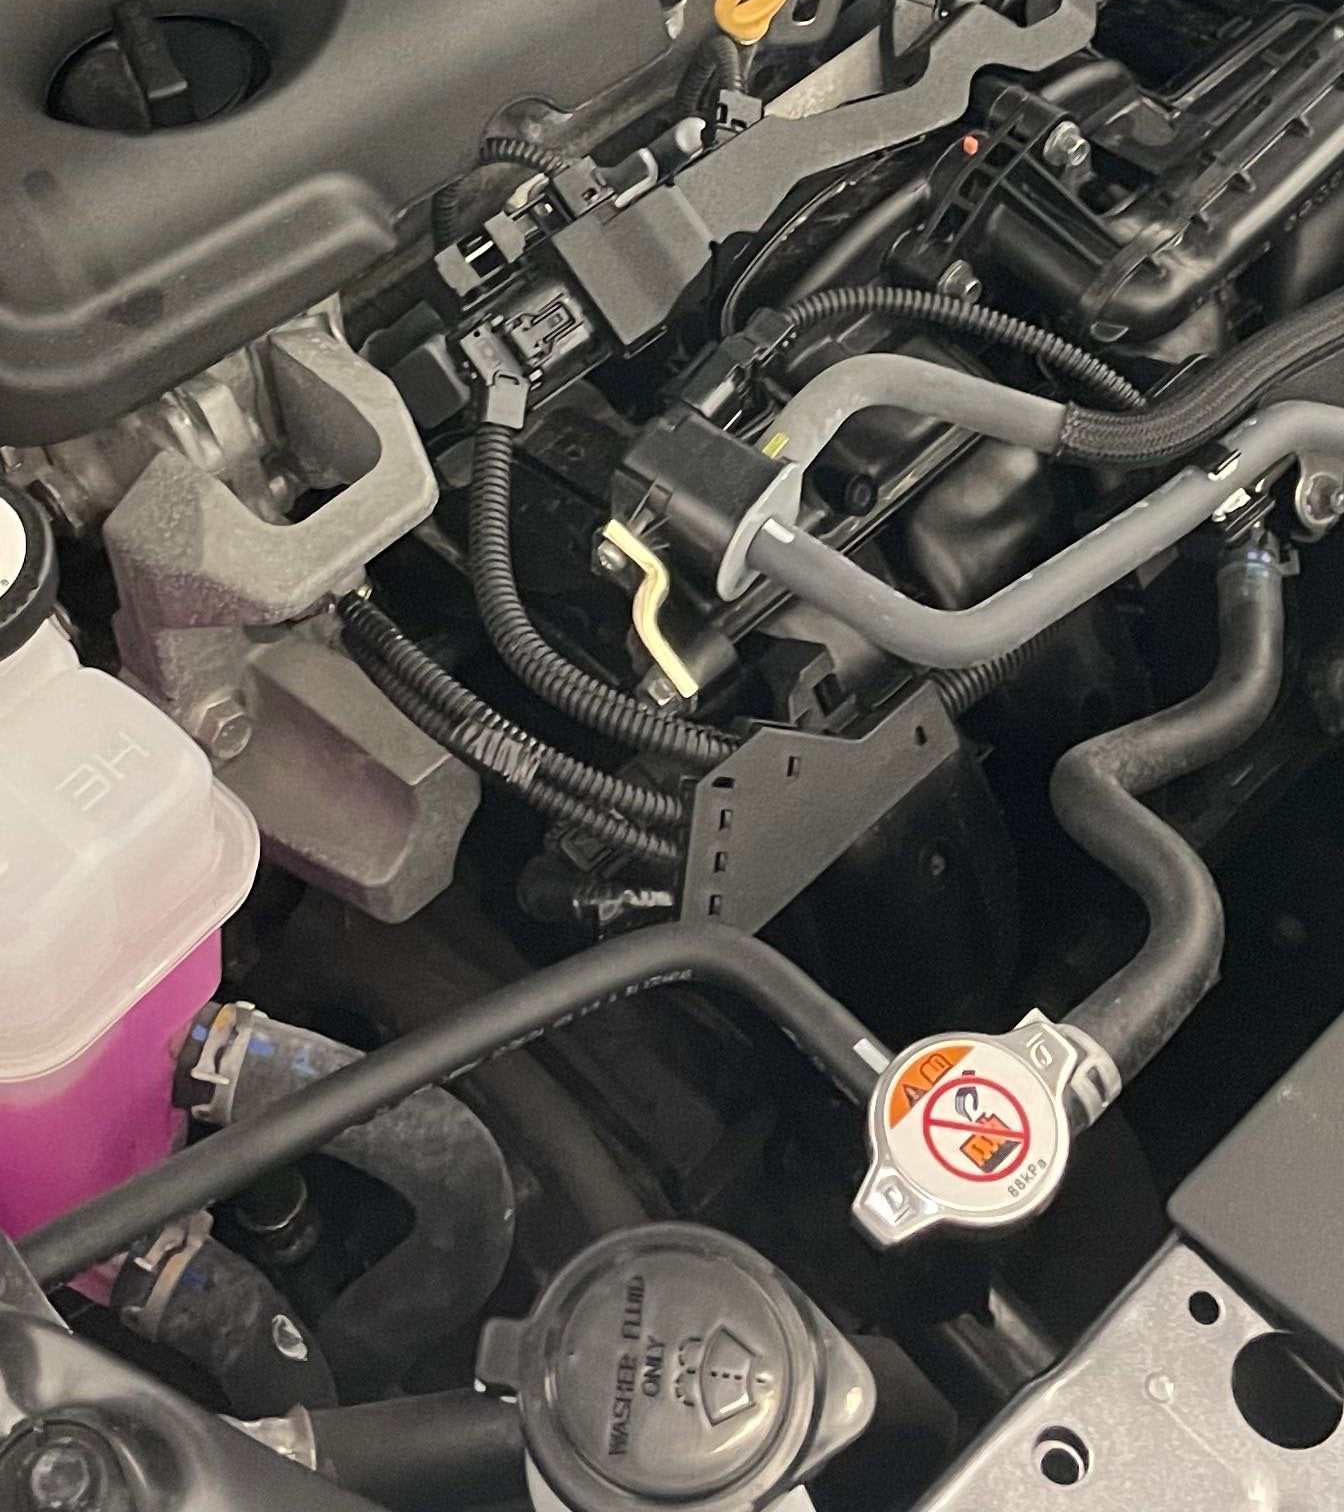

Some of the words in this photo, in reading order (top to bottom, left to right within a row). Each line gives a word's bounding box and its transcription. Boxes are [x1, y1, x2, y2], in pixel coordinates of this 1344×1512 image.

[1007, 1156, 1047, 1198] 88kPa
[621, 1274, 647, 1341] FLUID
[640, 1334, 668, 1399] ONLY
[607, 1352, 639, 1456] WASHER
